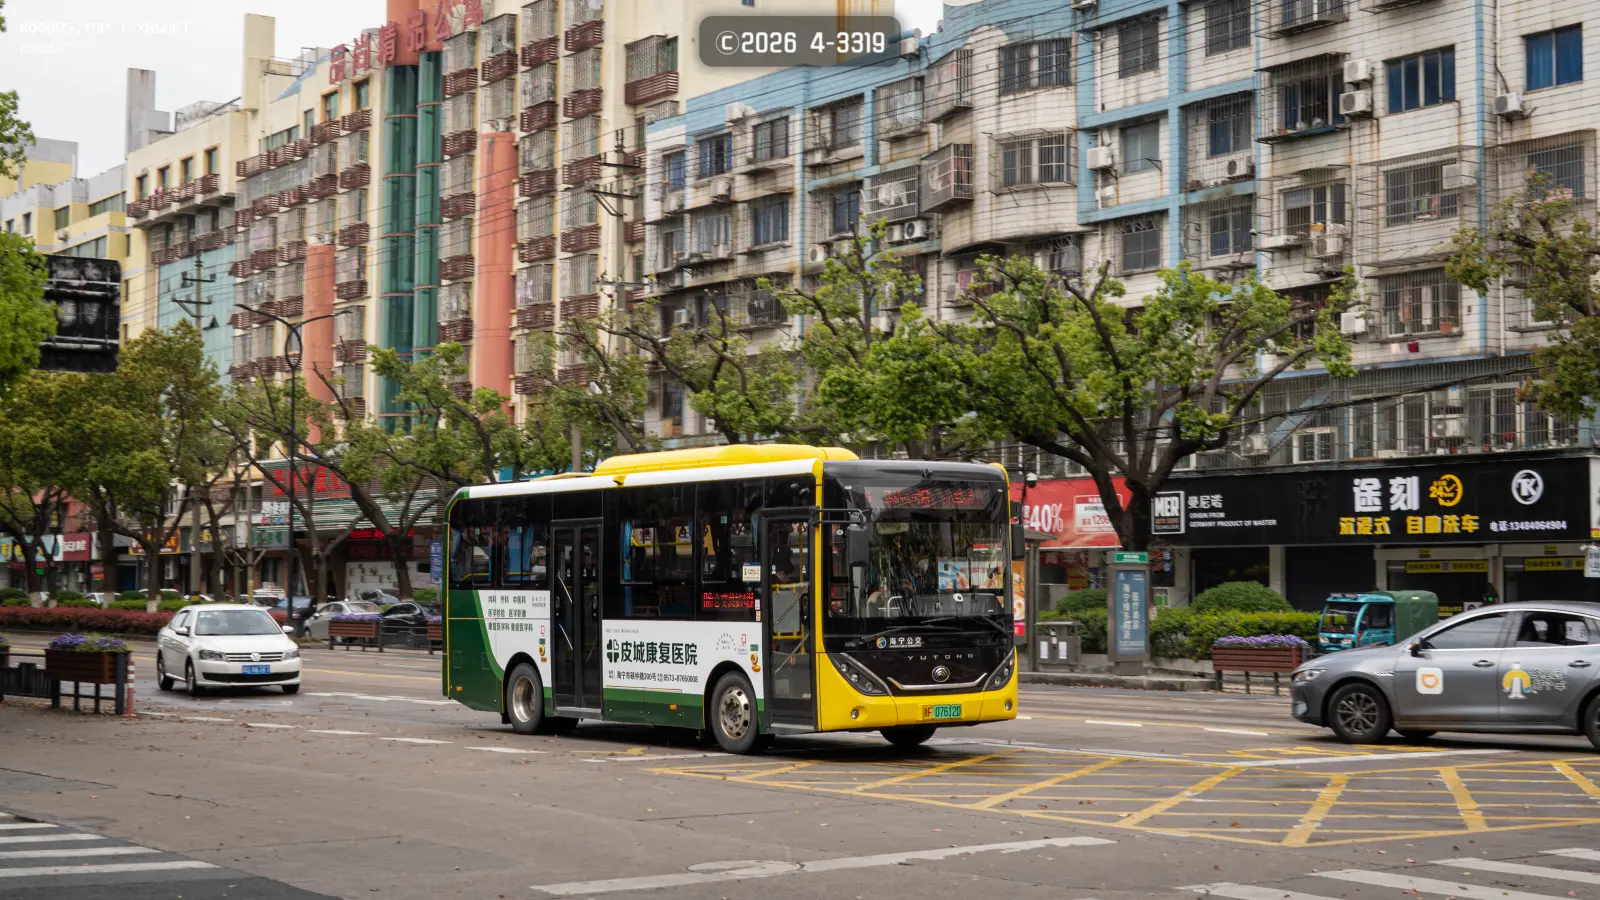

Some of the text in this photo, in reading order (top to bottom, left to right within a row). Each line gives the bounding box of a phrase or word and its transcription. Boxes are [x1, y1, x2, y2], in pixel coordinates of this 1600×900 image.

[1352, 475, 1420, 513] 途刻
[1154, 496, 1180, 517] MER
[1339, 514, 1479, 535] 沉浸式 自助洗车
[889, 637, 922, 645] 海宁公交
[621, 641, 698, 666] 皮城康复医院
[908, 653, 974, 661] YUTONG
